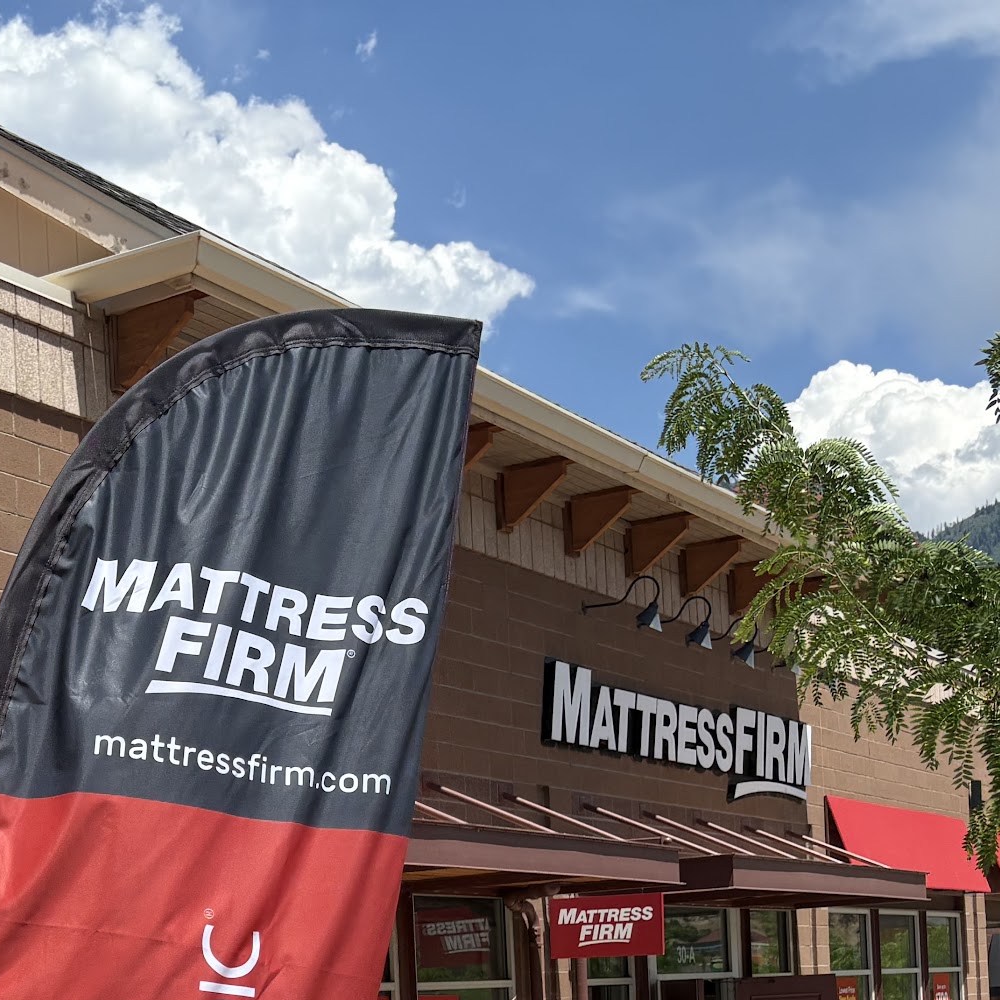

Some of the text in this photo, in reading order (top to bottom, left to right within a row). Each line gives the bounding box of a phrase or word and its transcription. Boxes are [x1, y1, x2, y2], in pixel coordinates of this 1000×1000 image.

[81, 558, 429, 645] MATTRESS
[93, 734, 391, 795] mattressfirm.com
[558, 906, 654, 925] MATTRESS
[579, 923, 634, 941] FIRM
[676, 946, 696, 963] 30-A
